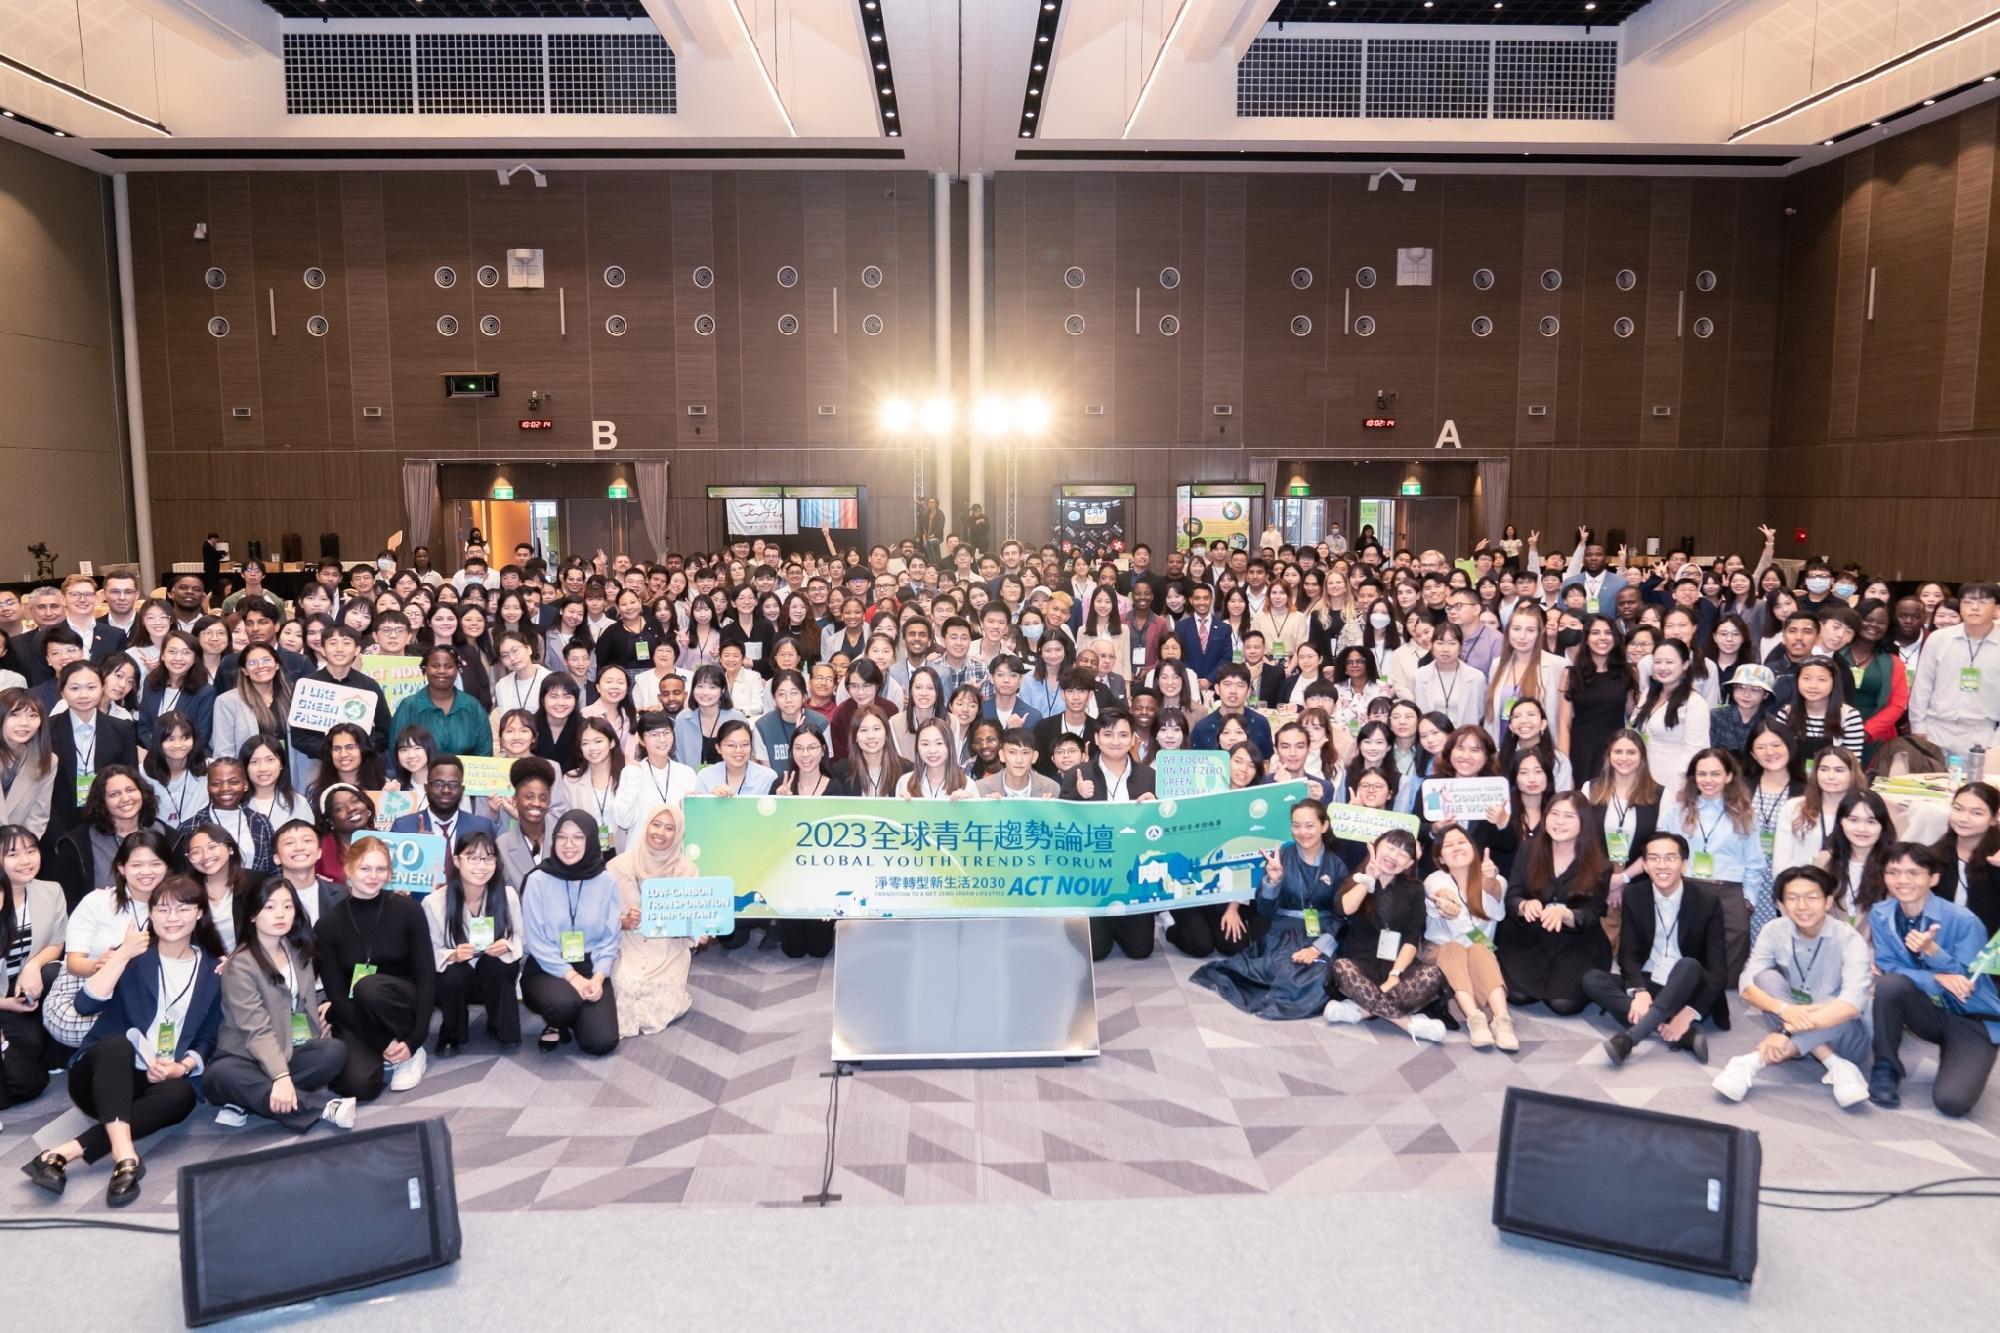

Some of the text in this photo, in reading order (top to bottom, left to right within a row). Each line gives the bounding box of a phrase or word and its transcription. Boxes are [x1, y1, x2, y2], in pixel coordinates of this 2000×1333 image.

[592, 421, 618, 450] B
[1435, 420, 1462, 448] A
[300, 686, 336, 701] I LIKE
[298, 699, 339, 715] GREEN
[1162, 755, 1209, 764] WE FOCUS
[1162, 766, 1223, 775] ON NET-ZERO
[1162, 777, 1192, 786] GREEN
[1333, 809, 1351, 821] NO
[795, 854, 1113, 868] GLOBAL YOUTH TRENDS FORUM
[1008, 875, 1113, 897] ACT NOW
[648, 910, 719, 921] IS IMPORTANT
